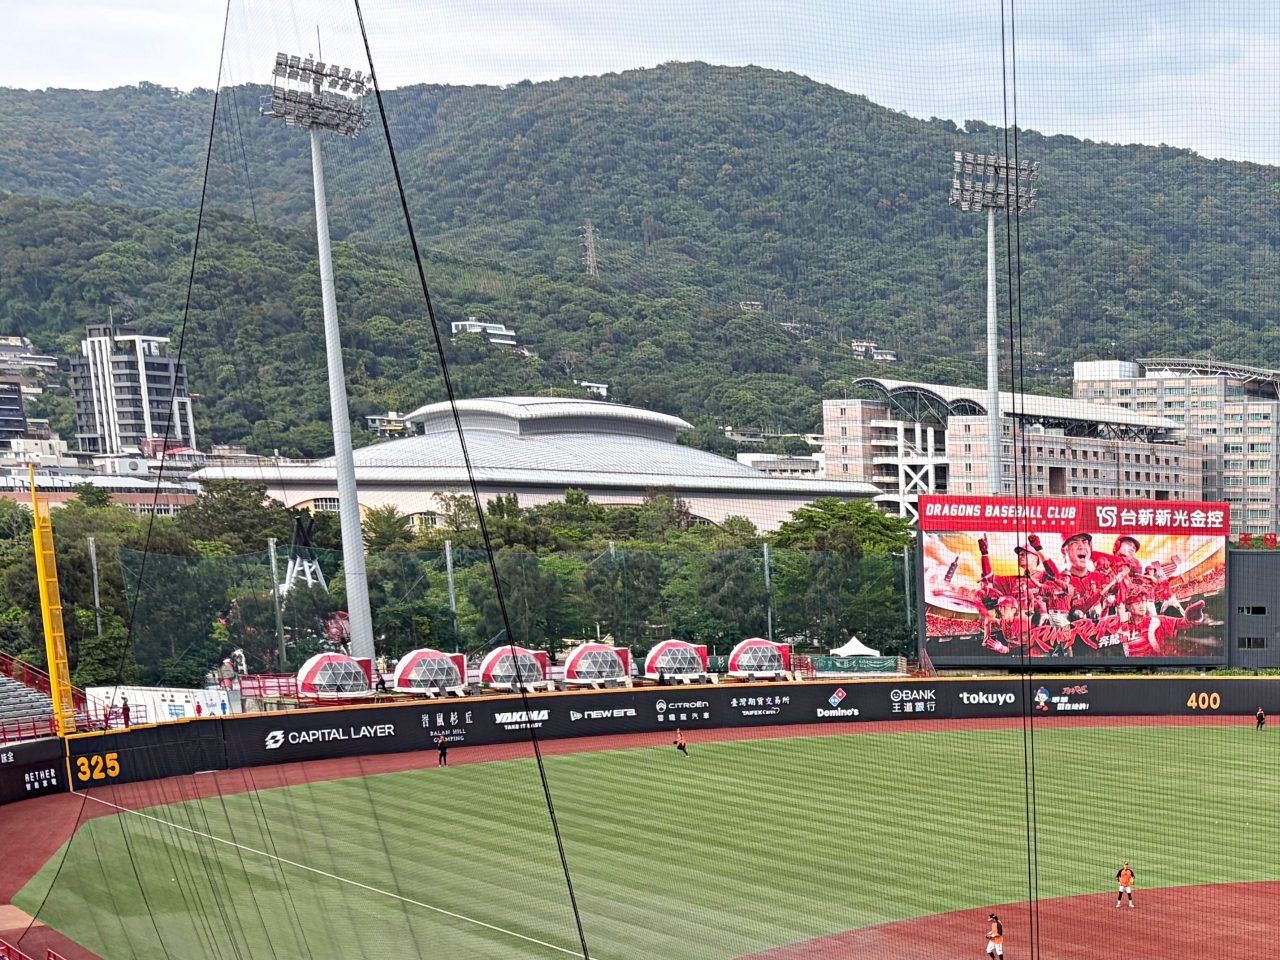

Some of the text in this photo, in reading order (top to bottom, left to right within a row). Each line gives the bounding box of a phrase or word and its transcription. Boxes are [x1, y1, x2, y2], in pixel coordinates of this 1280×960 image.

[926, 504, 1076, 518] DRAGONS BASEBALL CLUB
[1120, 508, 1224, 528] 台新新光金控
[960, 692, 1015, 705] tokuyo
[1187, 692, 1220, 709] 400
[817, 708, 859, 717] Domino's
[892, 702, 936, 712] 王道銀行
[495, 710, 549, 723] YAKIMA
[585, 710, 612, 719] NEW
[288, 725, 394, 744] CAPITAL LAYER
[76, 753, 120, 781] 325
[25, 769, 56, 783] AETHER
